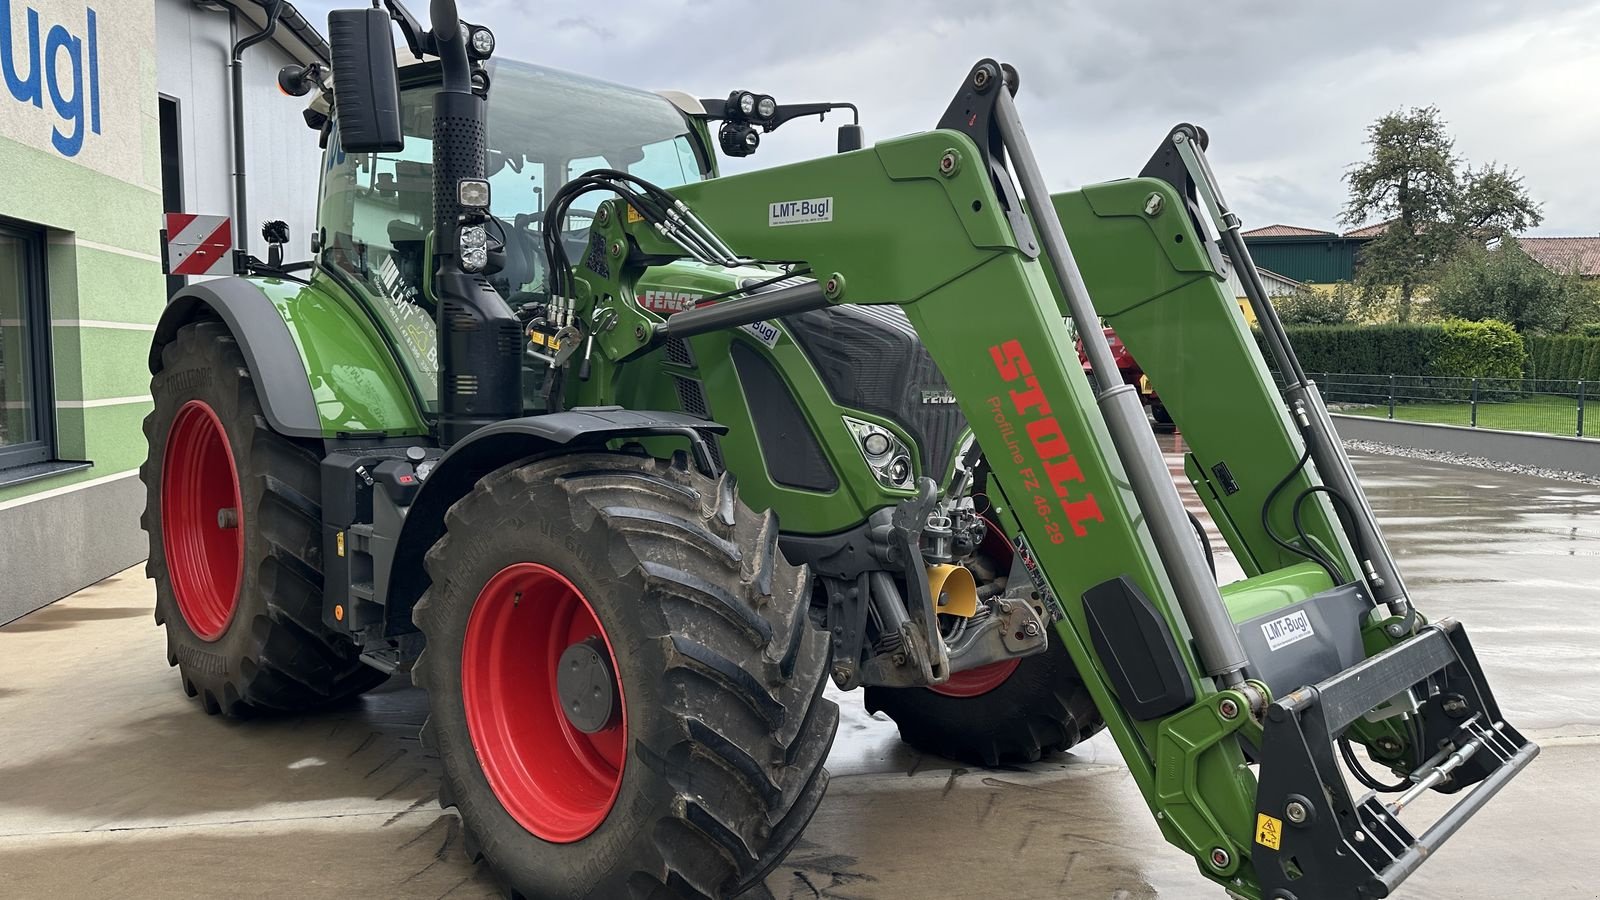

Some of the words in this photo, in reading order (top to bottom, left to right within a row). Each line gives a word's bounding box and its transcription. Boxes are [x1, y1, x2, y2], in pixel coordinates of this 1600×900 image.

[773, 199, 829, 218] LMT-Bugl
[390, 284, 414, 321] LMT
[988, 339, 1105, 538] STOLL
[986, 396, 1025, 465] ProfiLine
[1018, 467, 1041, 492] FZ
[1033, 496, 1066, 545] 46-29
[1264, 612, 1308, 641] LMT-Bugl
